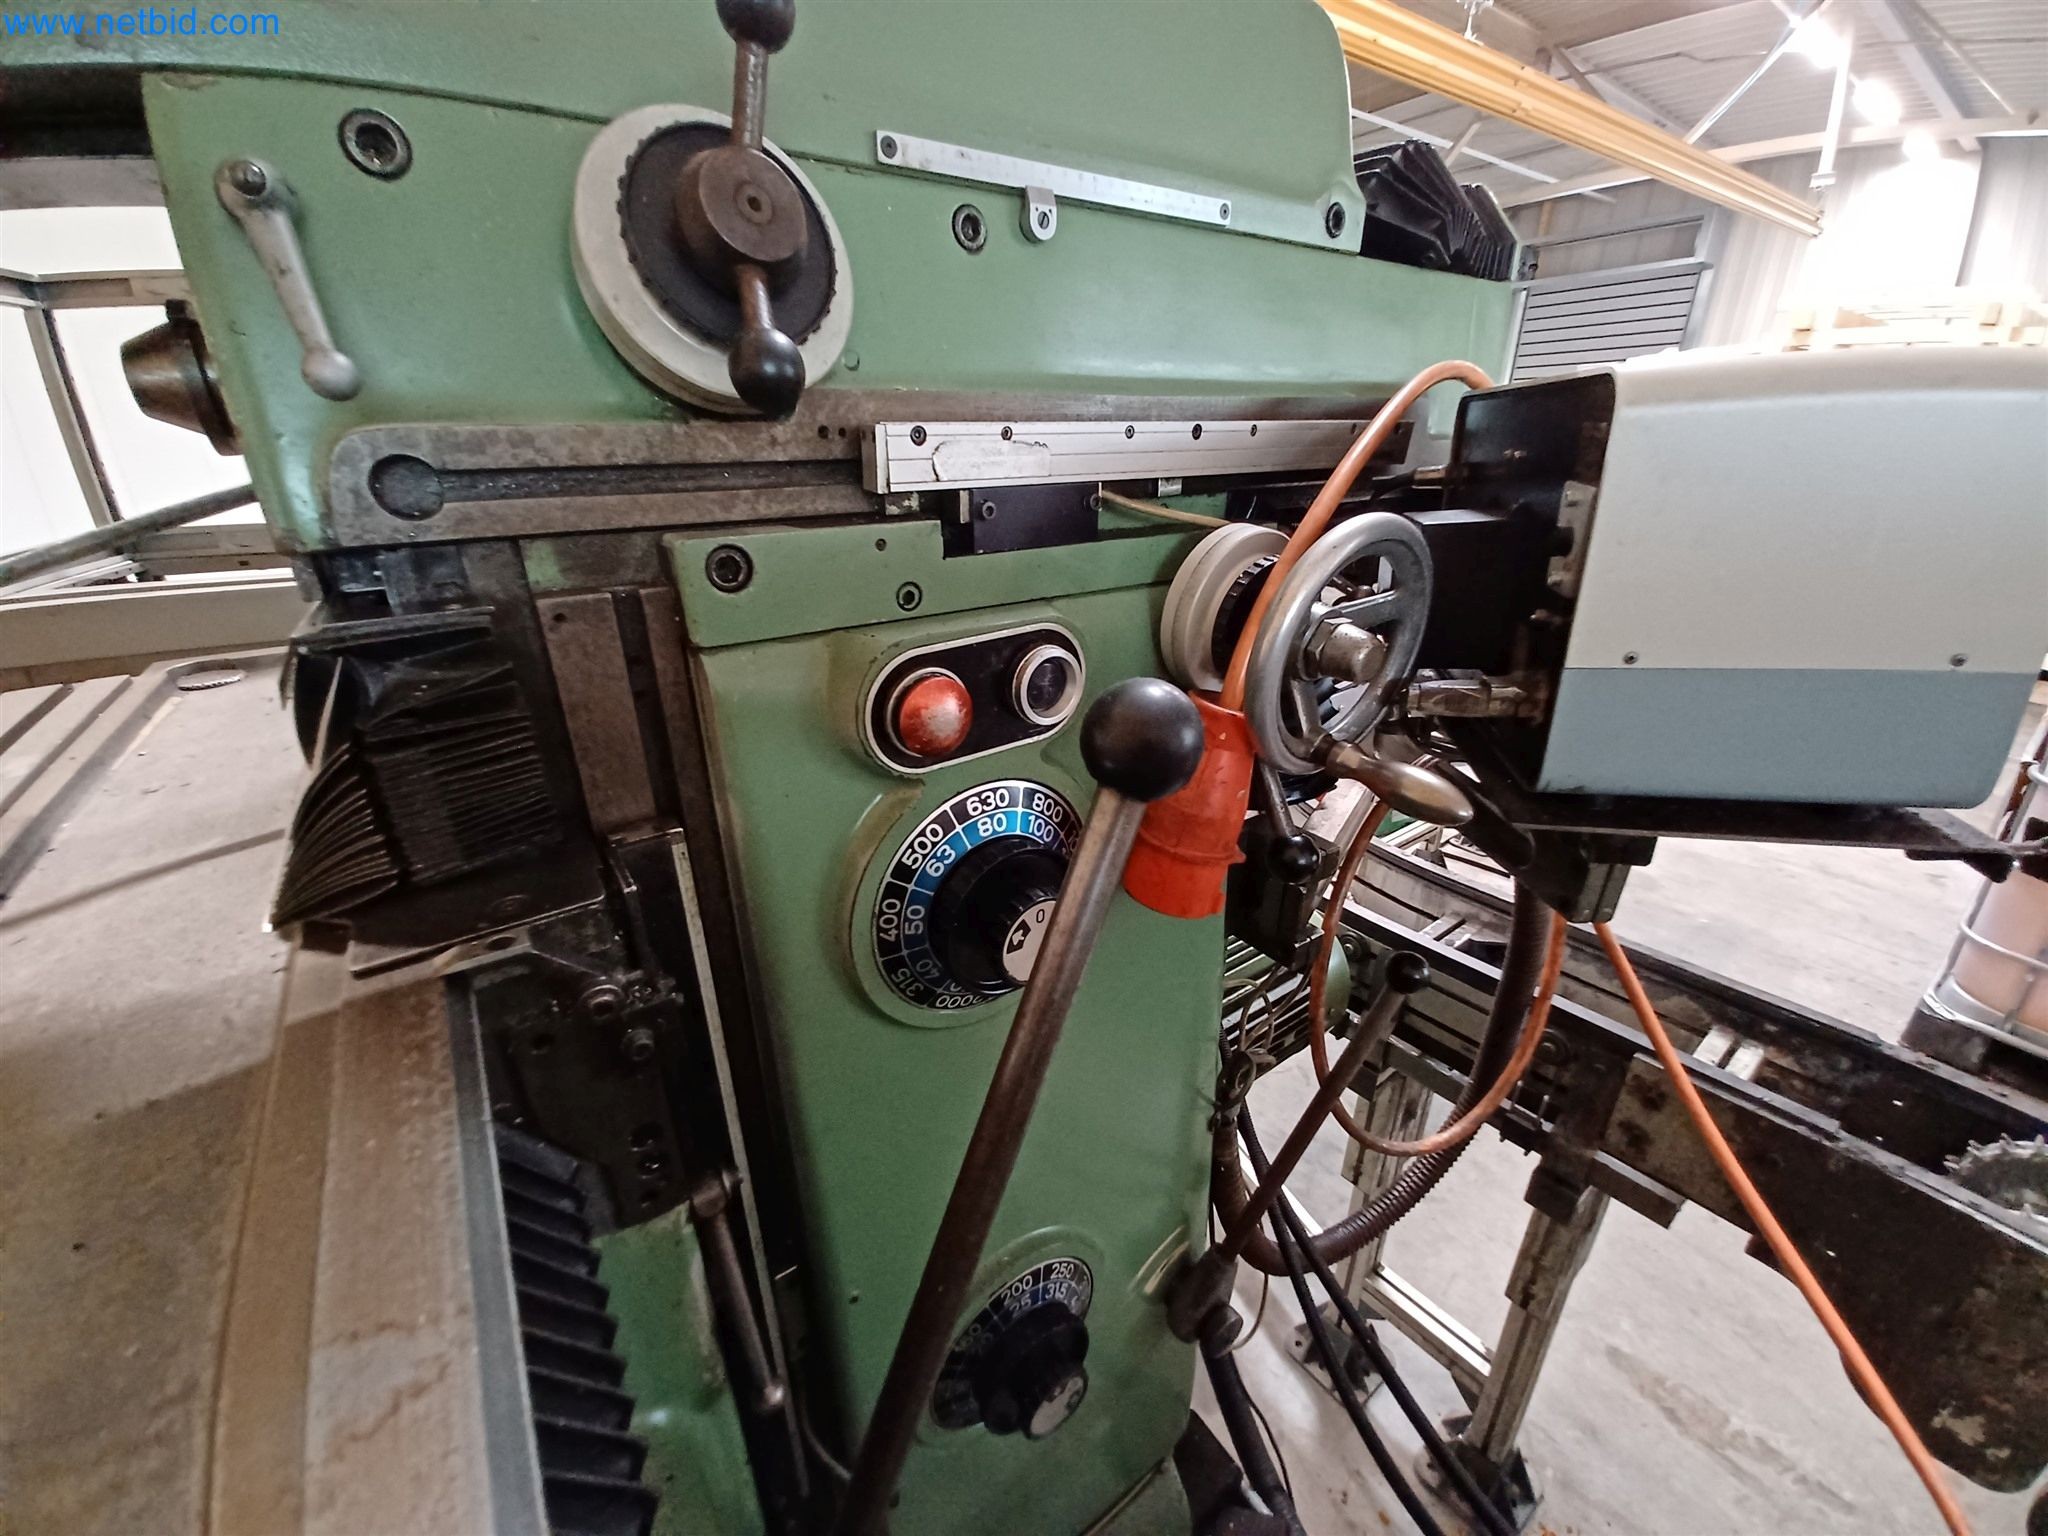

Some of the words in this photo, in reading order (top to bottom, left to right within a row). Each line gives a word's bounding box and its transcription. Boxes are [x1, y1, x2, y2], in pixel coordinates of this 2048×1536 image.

[966, 789, 1010, 816] 630
[1033, 793, 1063, 823] 800
[977, 814, 1007, 837] 80
[1028, 816, 1054, 842] 100
[901, 823, 944, 870] 500
[926, 844, 956, 877] 63
[880, 898, 901, 942] 400
[905, 905, 925, 935] 50
[1035, 908, 1045, 924] 0
[890, 967, 924, 997] 315
[915, 959, 941, 980] 40
[1051, 1262, 1075, 1279] 250
[1001, 1275, 1033, 1304] 200
